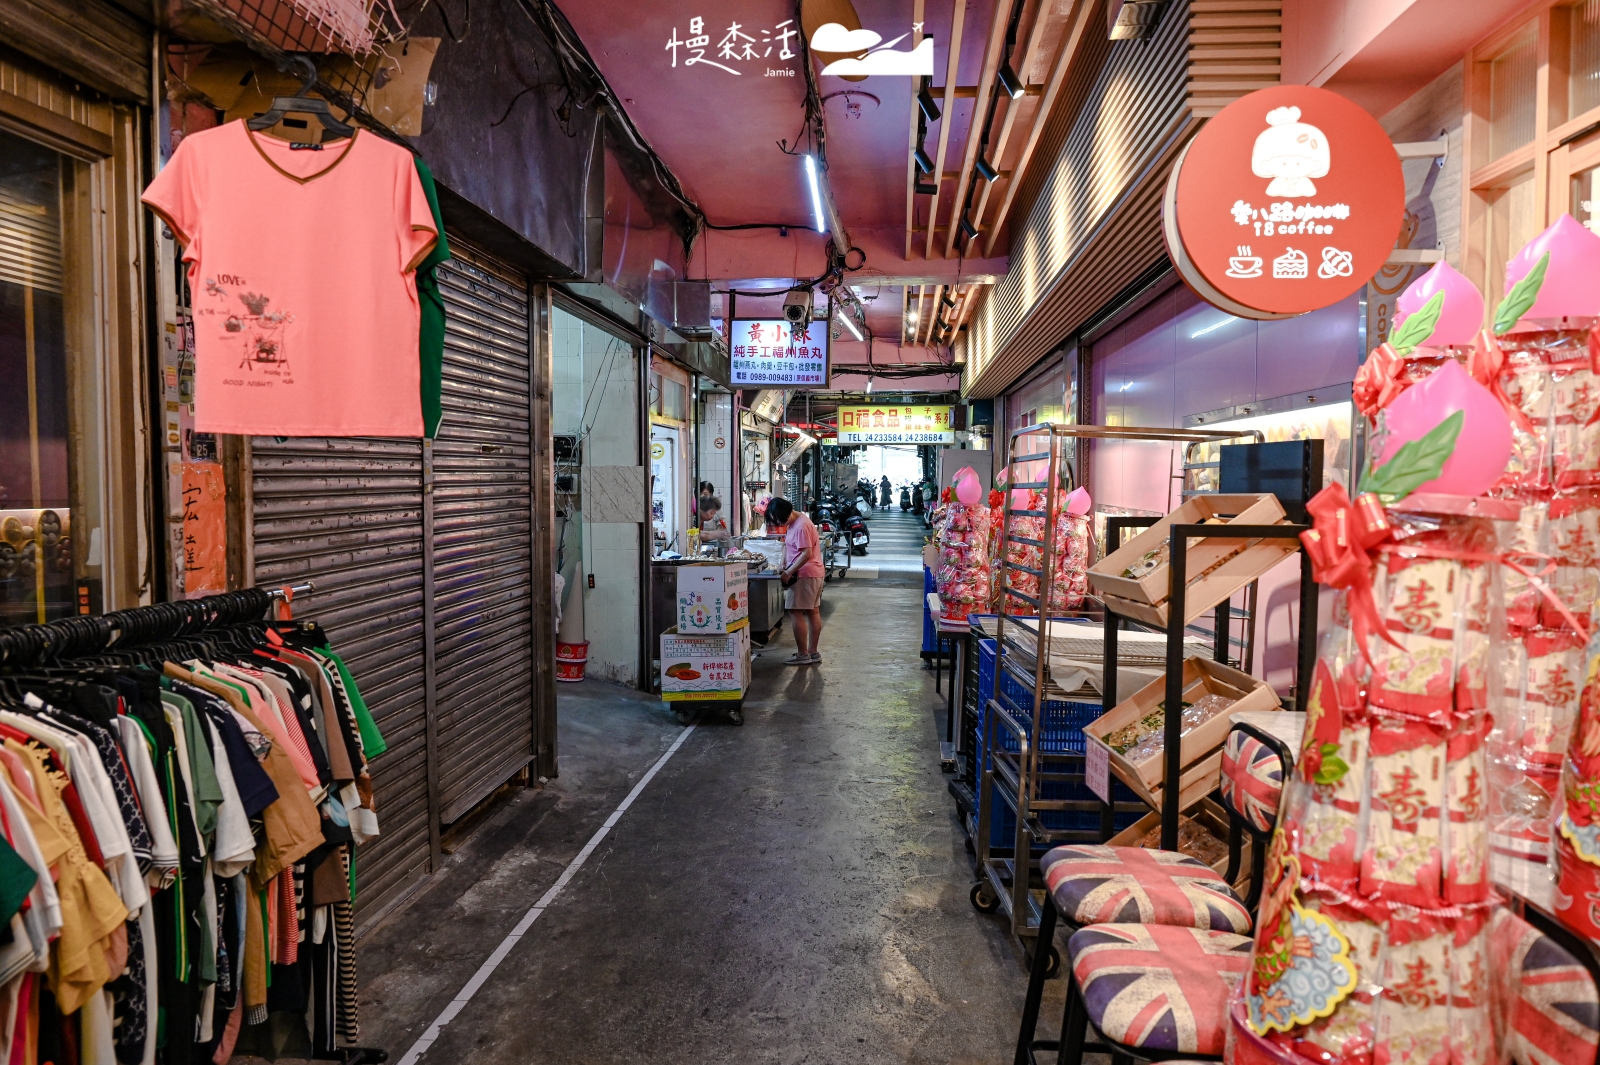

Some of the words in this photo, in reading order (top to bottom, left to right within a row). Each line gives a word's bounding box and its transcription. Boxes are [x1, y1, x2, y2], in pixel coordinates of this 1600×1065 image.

[1278, 221, 1334, 235] coffee
[217, 274, 240, 286] LOVE
[733, 345, 823, 359] 純手工福州魚丸
[749, 373, 793, 382] 0989-009483
[842, 408, 900, 429] 口福食品
[847, 433, 862, 442] TEL
[864, 433, 903, 442] 24233584
[905, 433, 943, 442] 24238684
